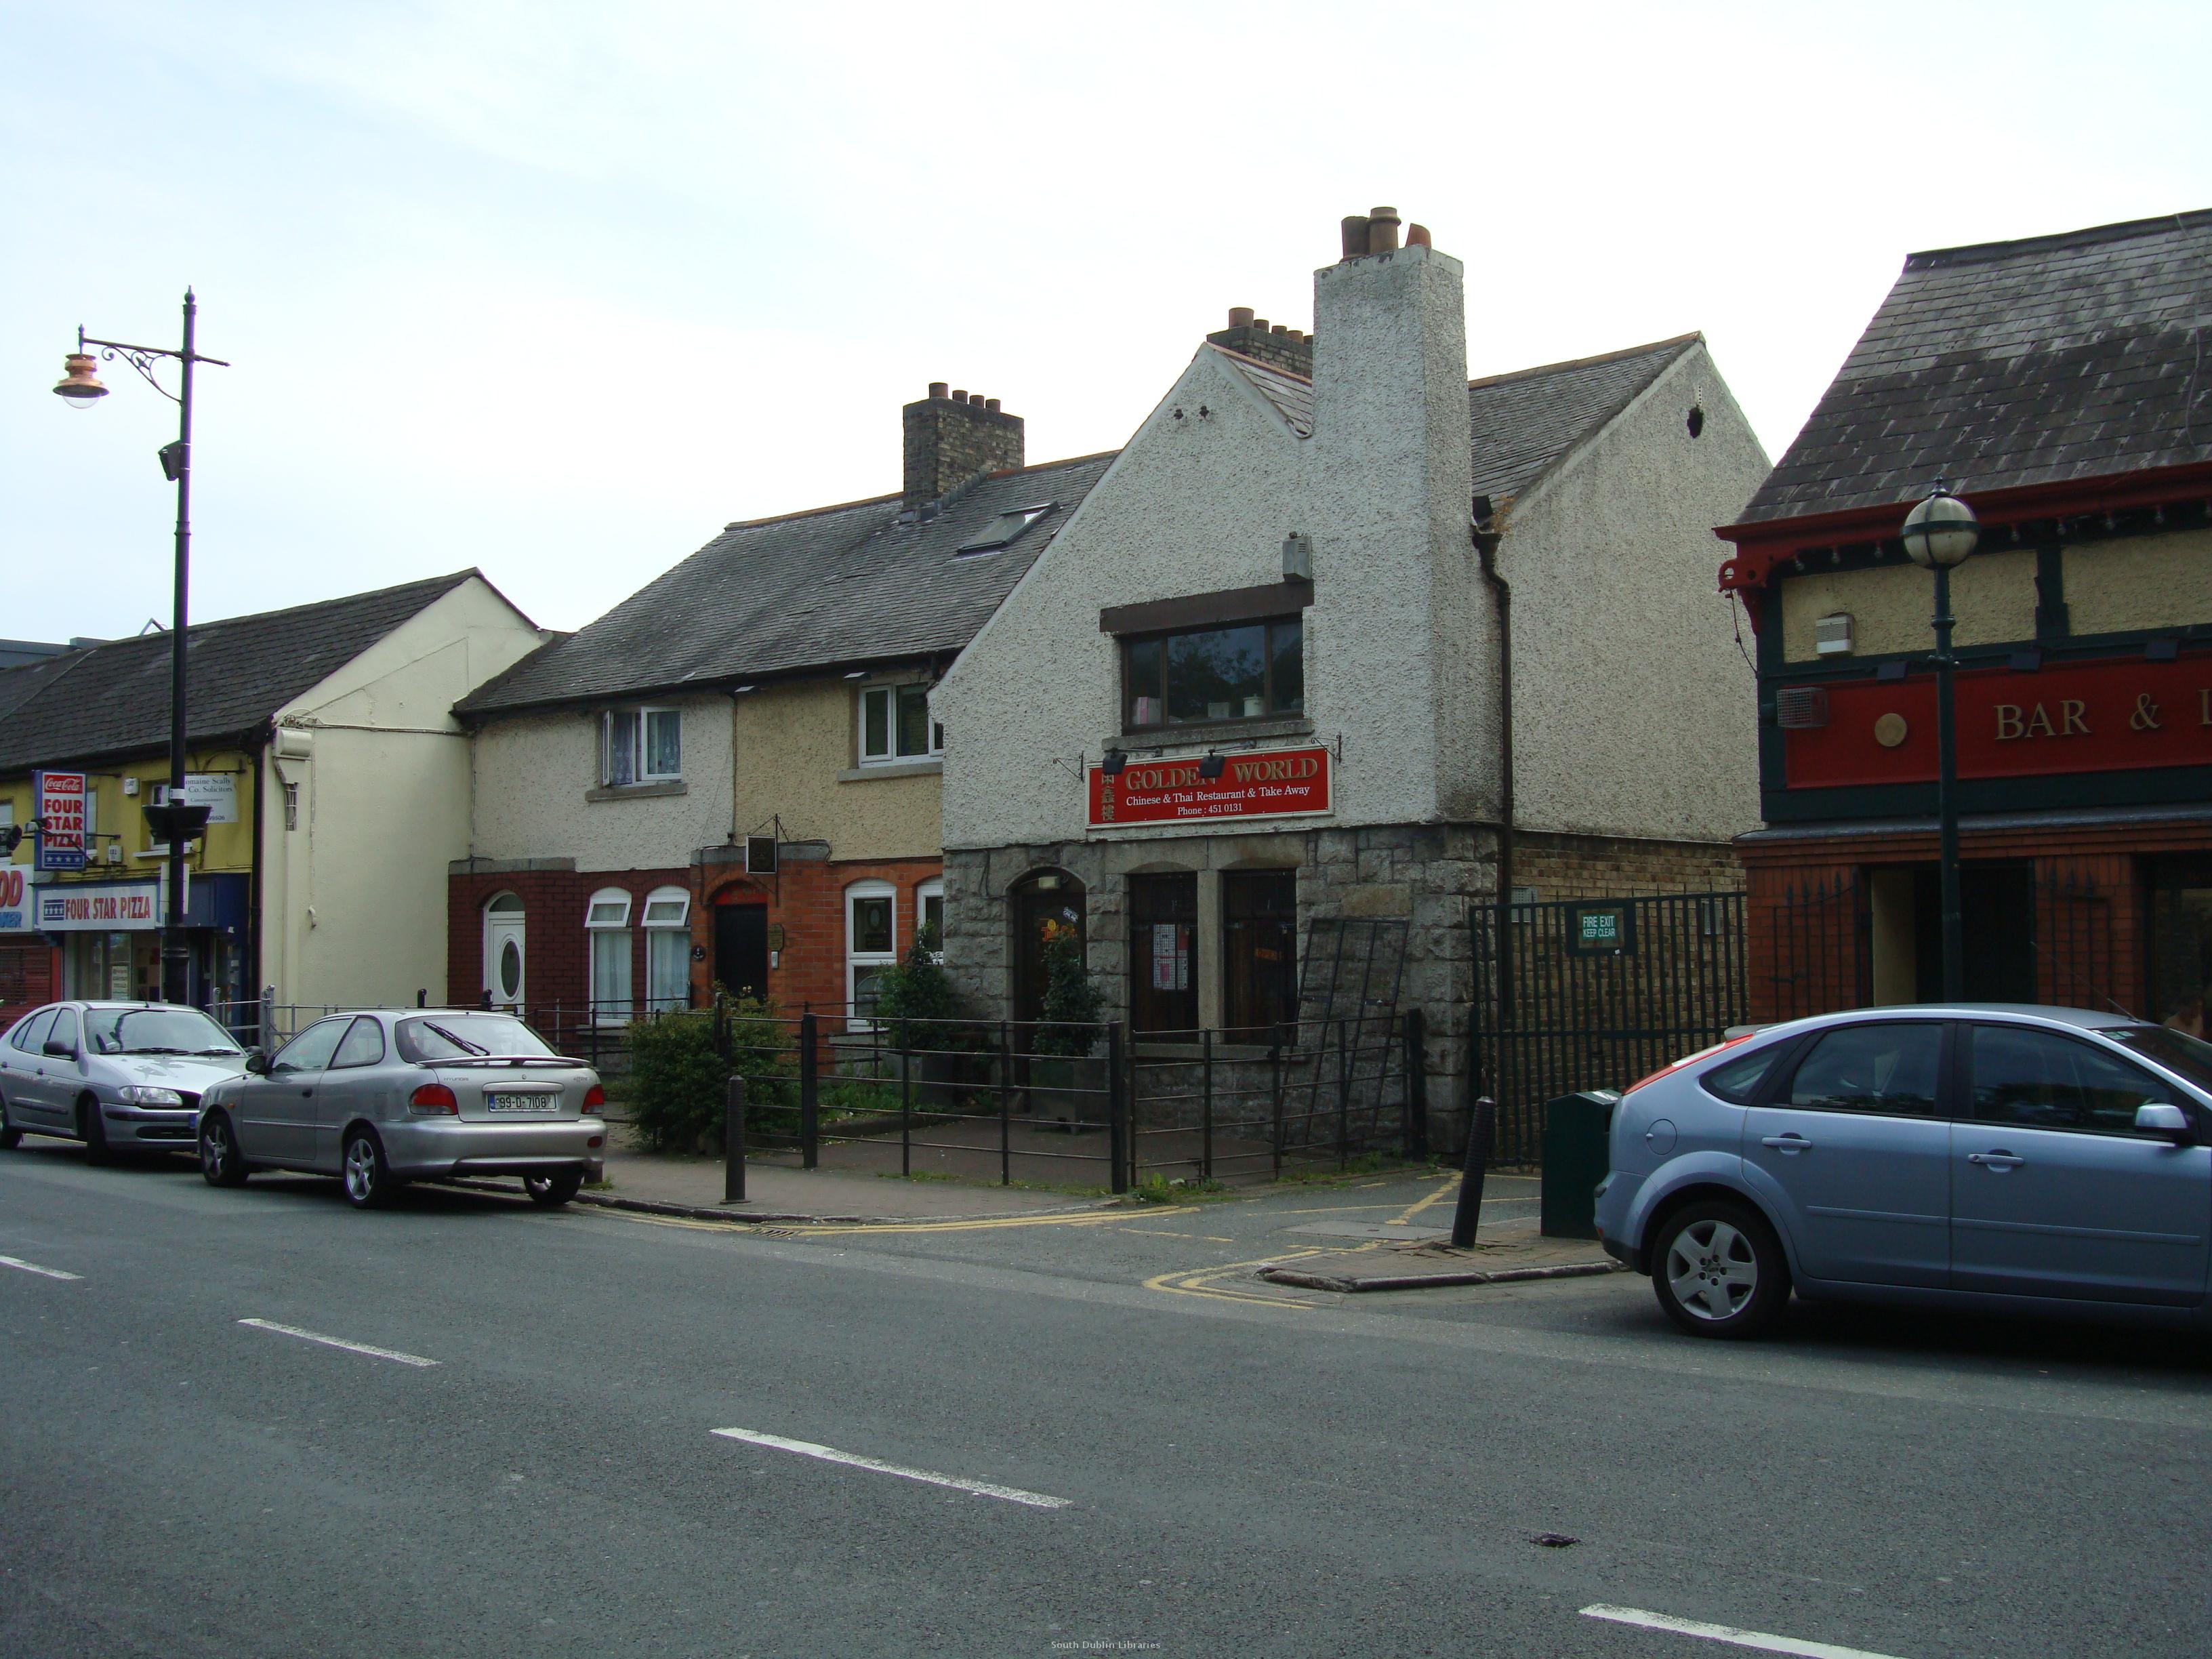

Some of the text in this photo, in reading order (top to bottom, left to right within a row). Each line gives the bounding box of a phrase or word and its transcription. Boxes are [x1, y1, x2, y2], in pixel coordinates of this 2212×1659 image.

[1992, 699, 2093, 740] BAR
[2129, 693, 2161, 731] &
[212, 777, 230, 785] Scally
[1125, 758, 1318, 791] GOLDE WORLD
[1126, 785, 1310, 806] Chinese & Thai Restaurant & Take Away
[44, 799, 83, 814] FOUR
[1177, 806, 1202, 815] Phone
[1208, 804, 1222, 814] 451
[1224, 803, 1243, 812] 0131
[45, 816, 83, 831] STAR
[44, 833, 83, 847] PIZZA
[66, 896, 151, 920] FOUR STAR PIZZA
[1583, 916, 1614, 928] FIRE EXIT
[1583, 928, 1615, 937] KEEP CLEAR
